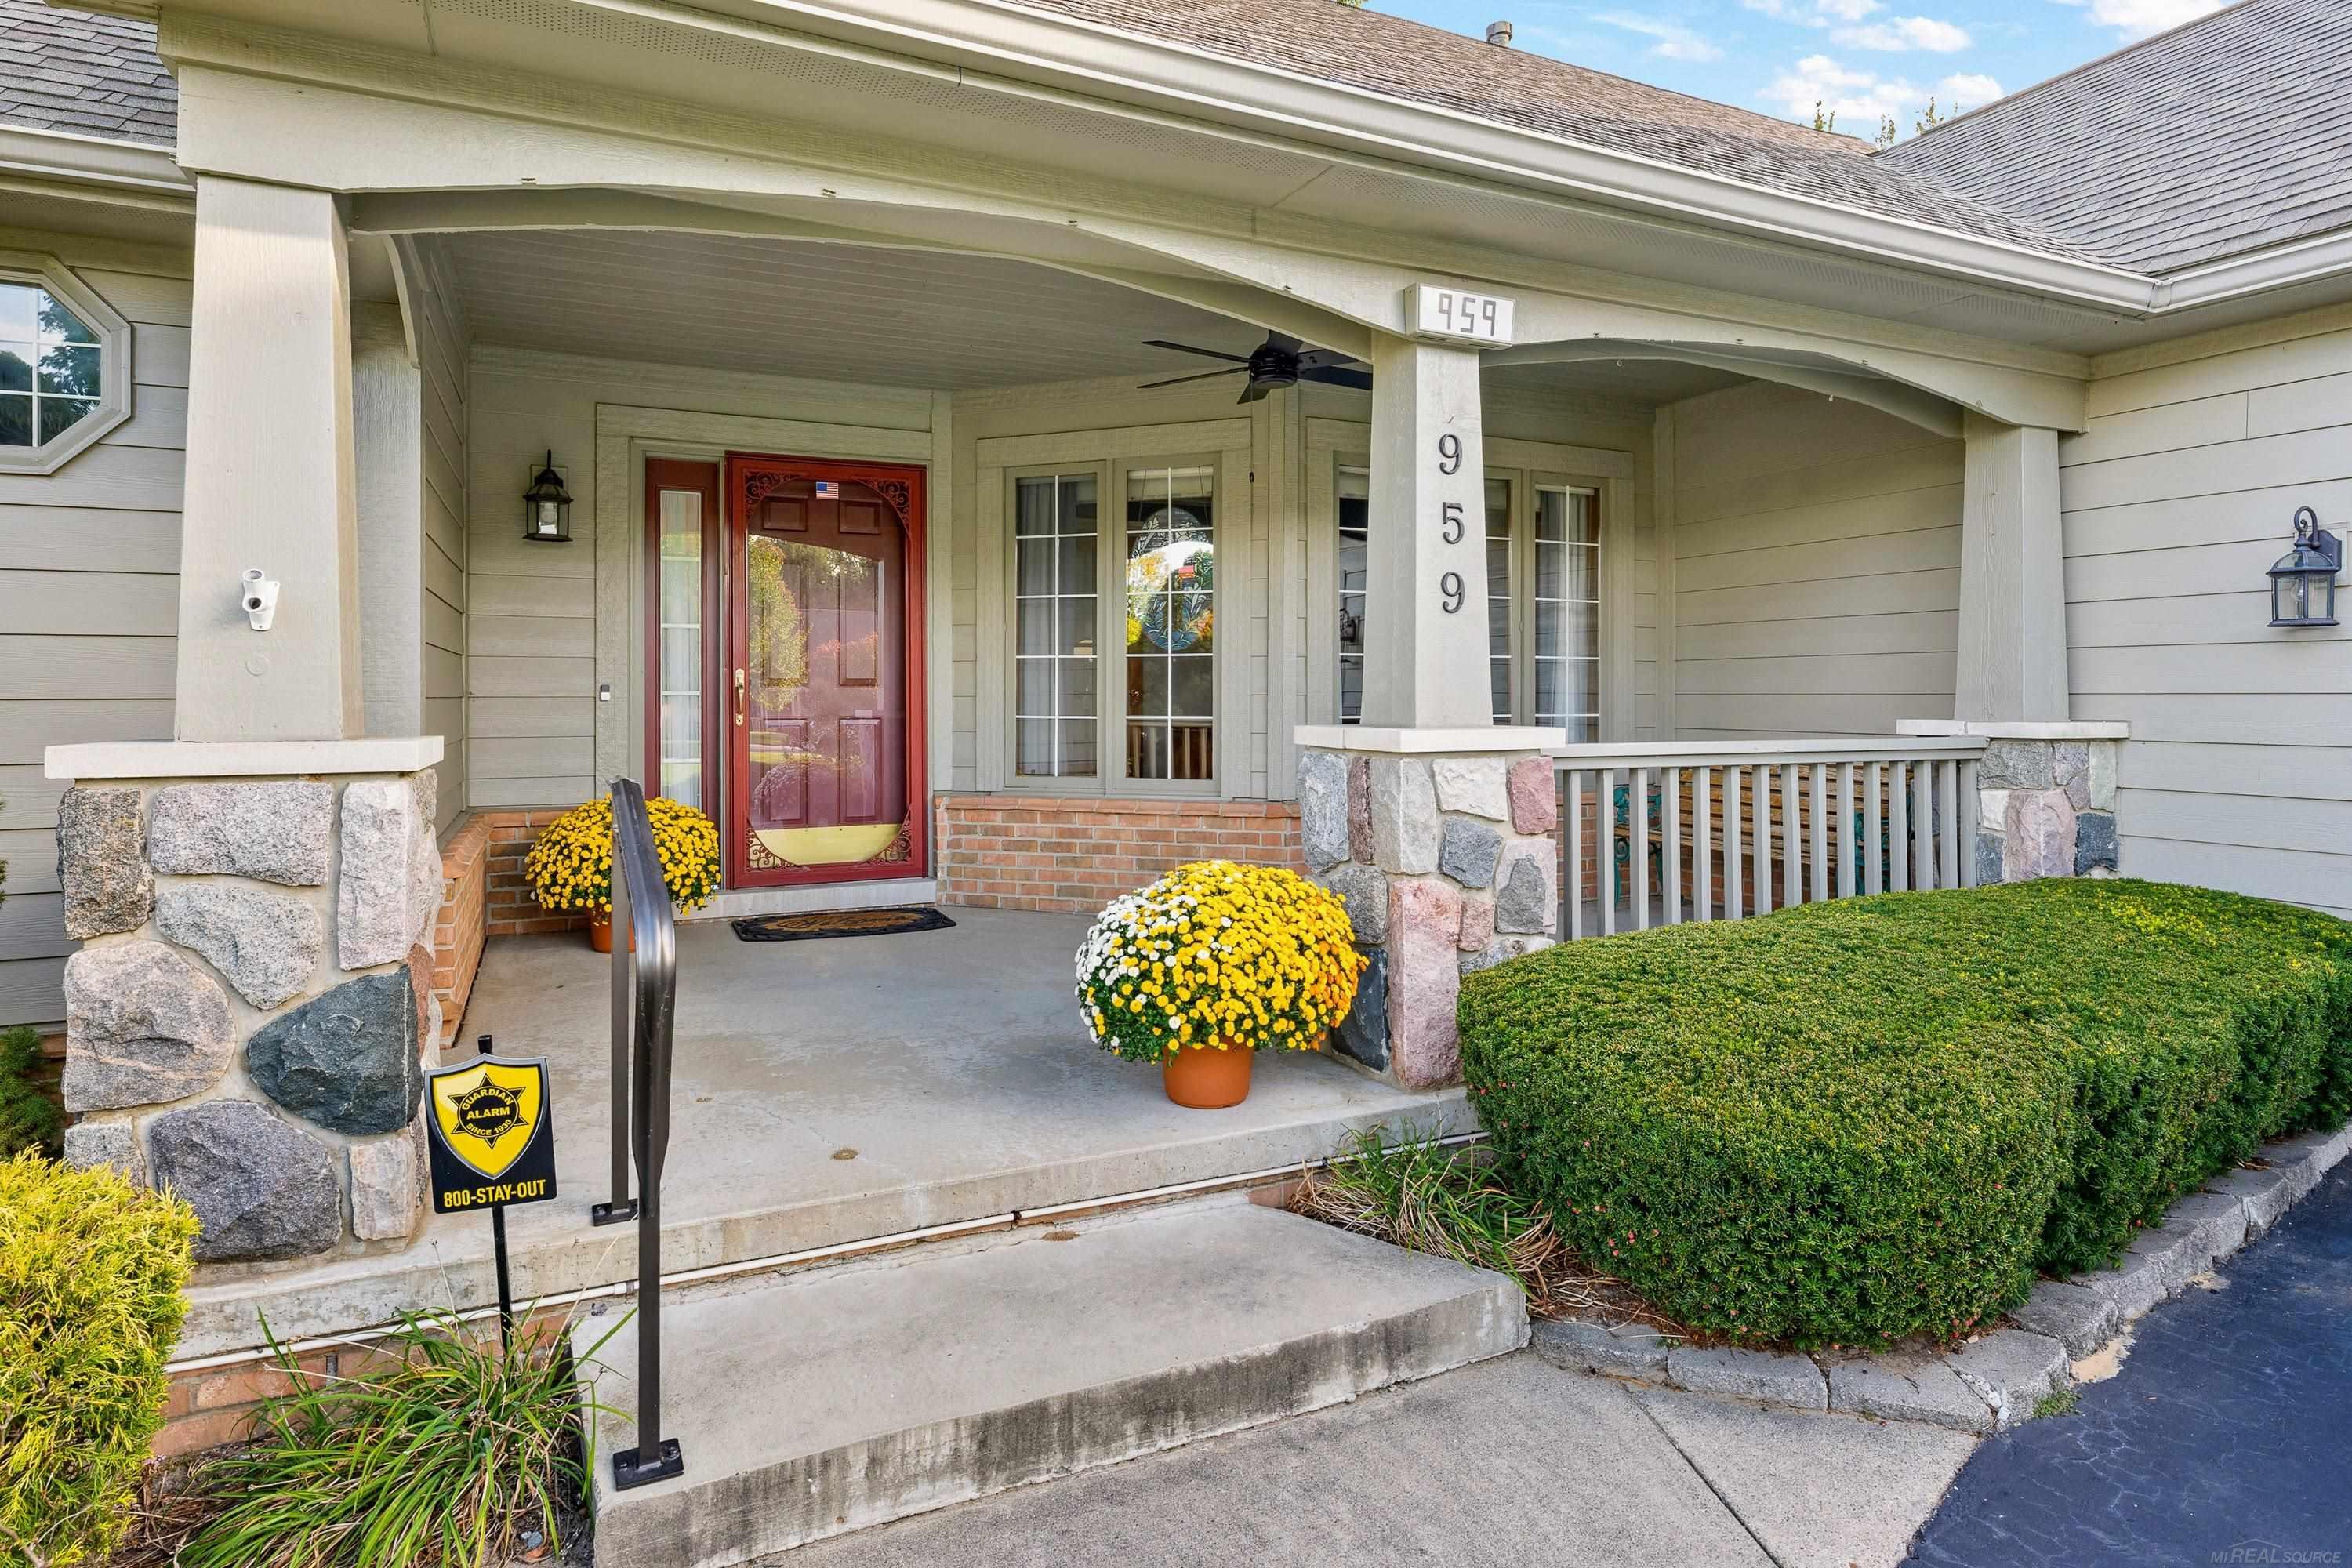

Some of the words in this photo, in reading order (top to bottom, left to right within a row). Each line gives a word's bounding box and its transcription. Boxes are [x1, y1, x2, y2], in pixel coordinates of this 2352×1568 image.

[1438, 292, 1496, 336] 959
[1438, 433, 1465, 614] 959
[462, 1088, 514, 1111] GUARDIAN
[466, 1106, 510, 1120] ALARM
[466, 1123, 492, 1136] SINCE
[494, 1119, 512, 1134] 1930
[443, 1179, 546, 1207] 800-STAY-OUT
